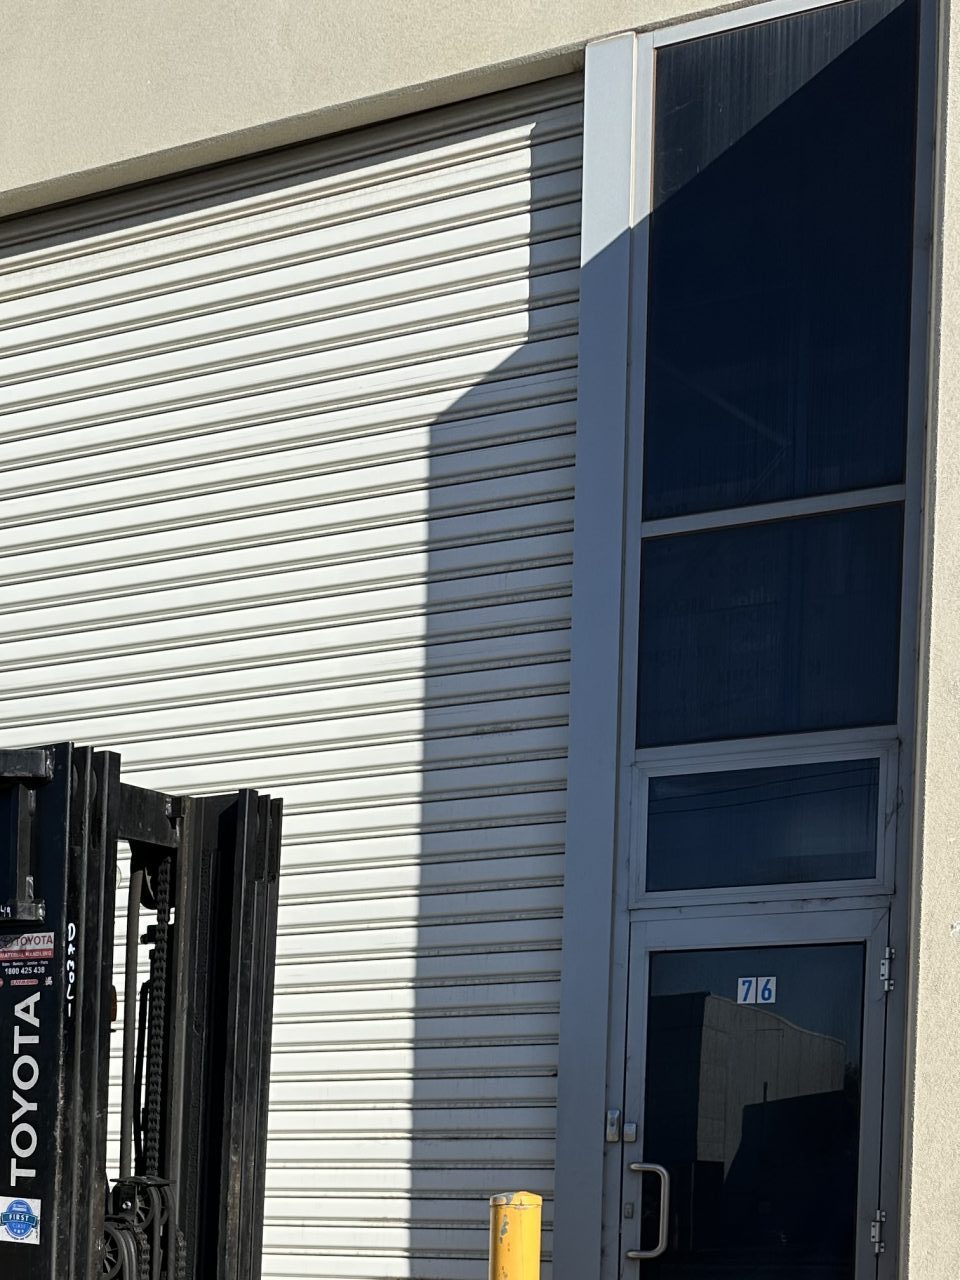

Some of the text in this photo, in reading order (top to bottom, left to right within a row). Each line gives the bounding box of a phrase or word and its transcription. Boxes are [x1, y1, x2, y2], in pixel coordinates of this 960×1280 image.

[16, 935, 53, 946] TOYOTA
[4, 967, 20, 975] 1800
[20, 966, 33, 974] 425
[66, 922, 76, 1018] DAMOLI
[741, 978, 772, 1002] 76
[10, 991, 41, 1187] TOYOTA
[8, 1213, 29, 1222] FIRST
